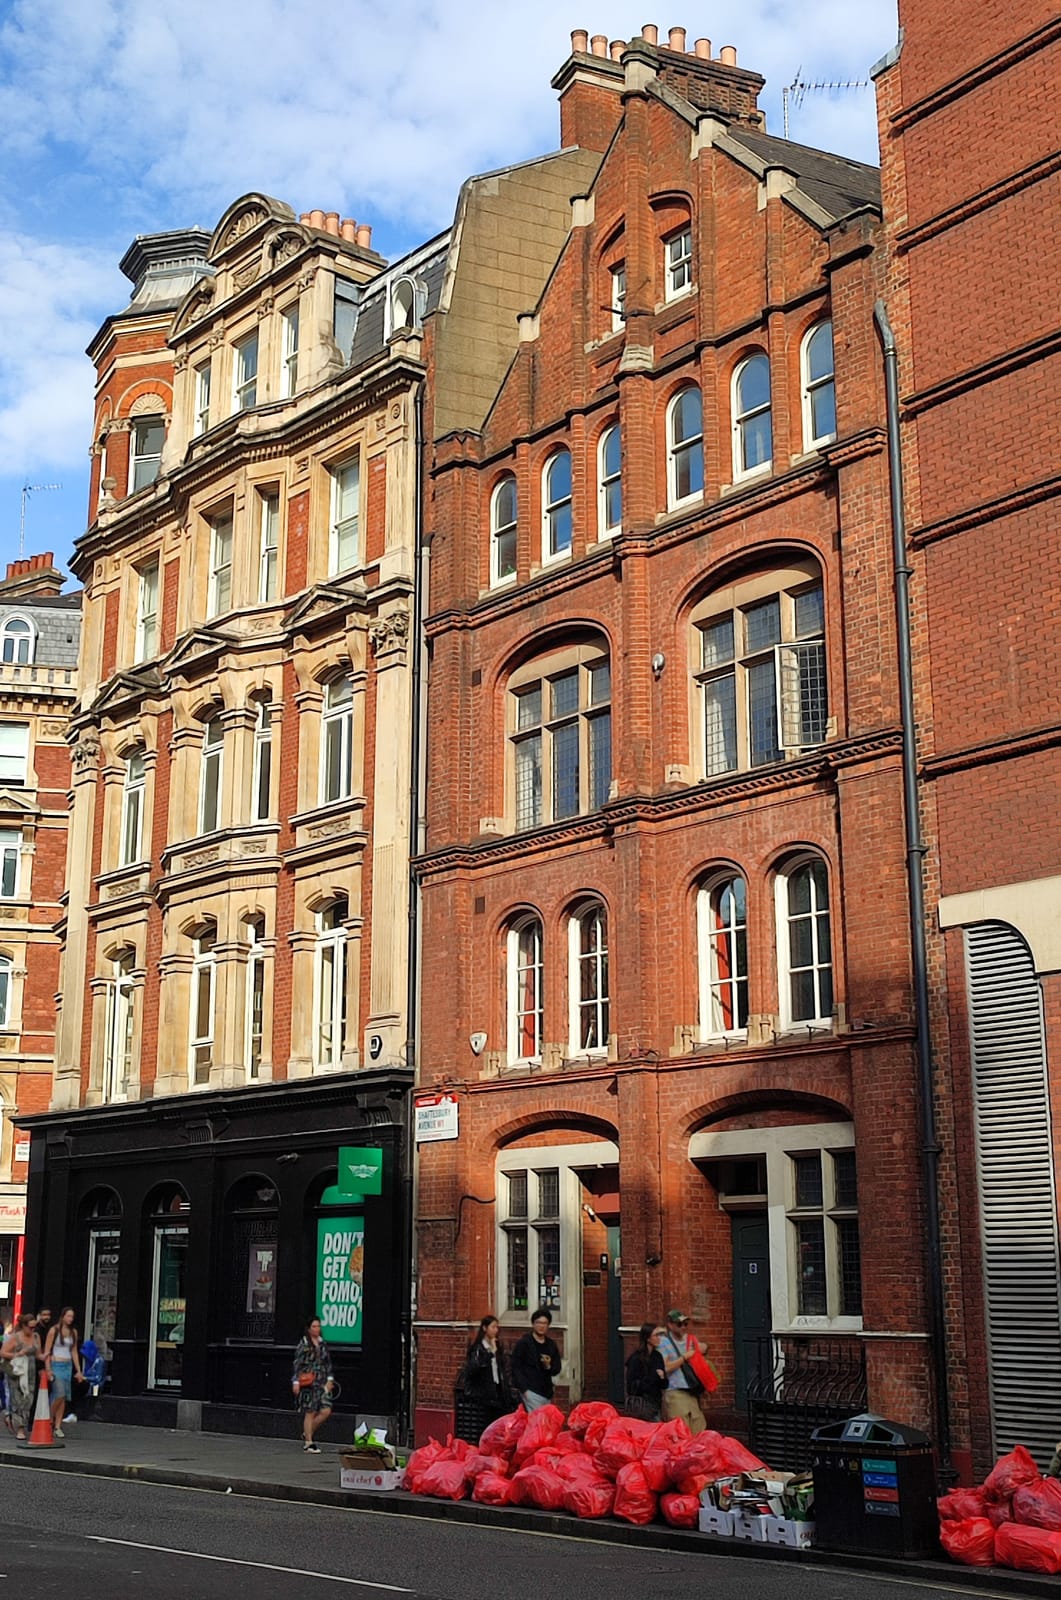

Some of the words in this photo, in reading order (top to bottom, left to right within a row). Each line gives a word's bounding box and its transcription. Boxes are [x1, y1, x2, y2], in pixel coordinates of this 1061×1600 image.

[418, 1109, 451, 1120] SHAFTESBURY
[418, 1121, 436, 1130] AVENUE
[323, 1231, 364, 1255] DON'T
[323, 1256, 348, 1279] GET
[320, 1304, 357, 1327] SOHO
